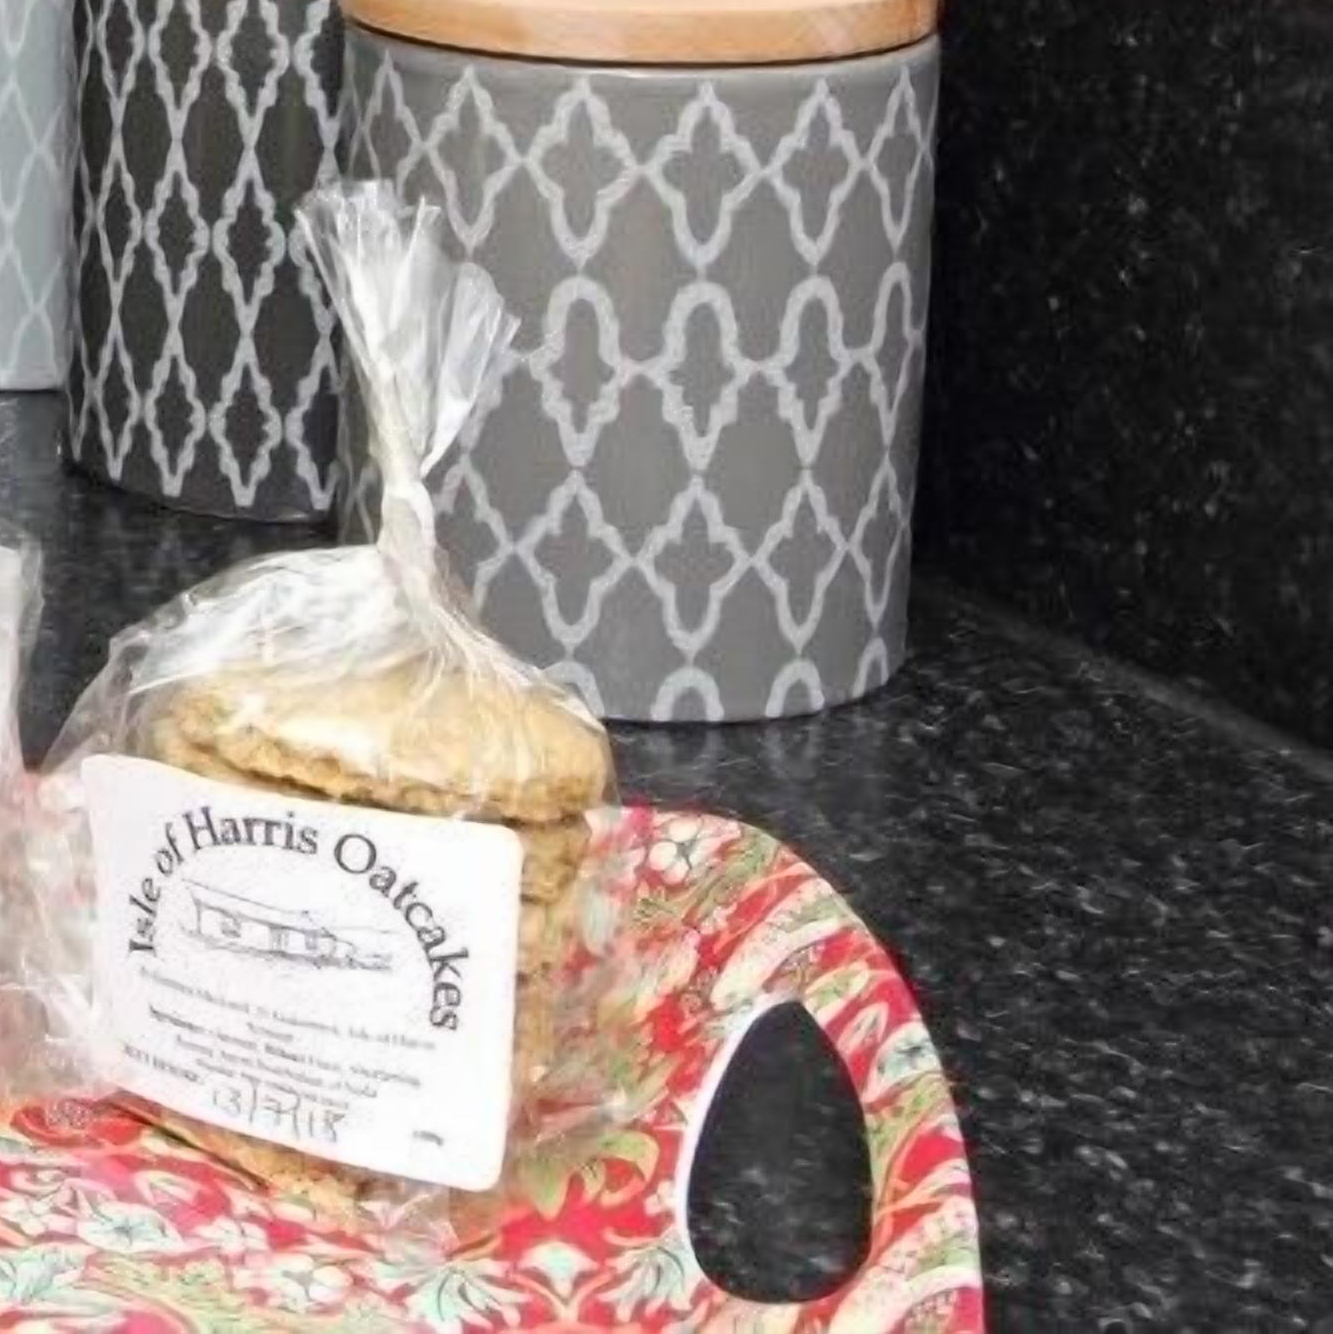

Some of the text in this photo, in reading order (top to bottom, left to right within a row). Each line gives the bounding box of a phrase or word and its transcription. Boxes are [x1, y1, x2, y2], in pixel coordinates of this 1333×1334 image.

[129, 877, 162, 957] Isle
[154, 822, 185, 876] of
[182, 805, 320, 856] Harris
[333, 832, 469, 1032] Oatcakes
